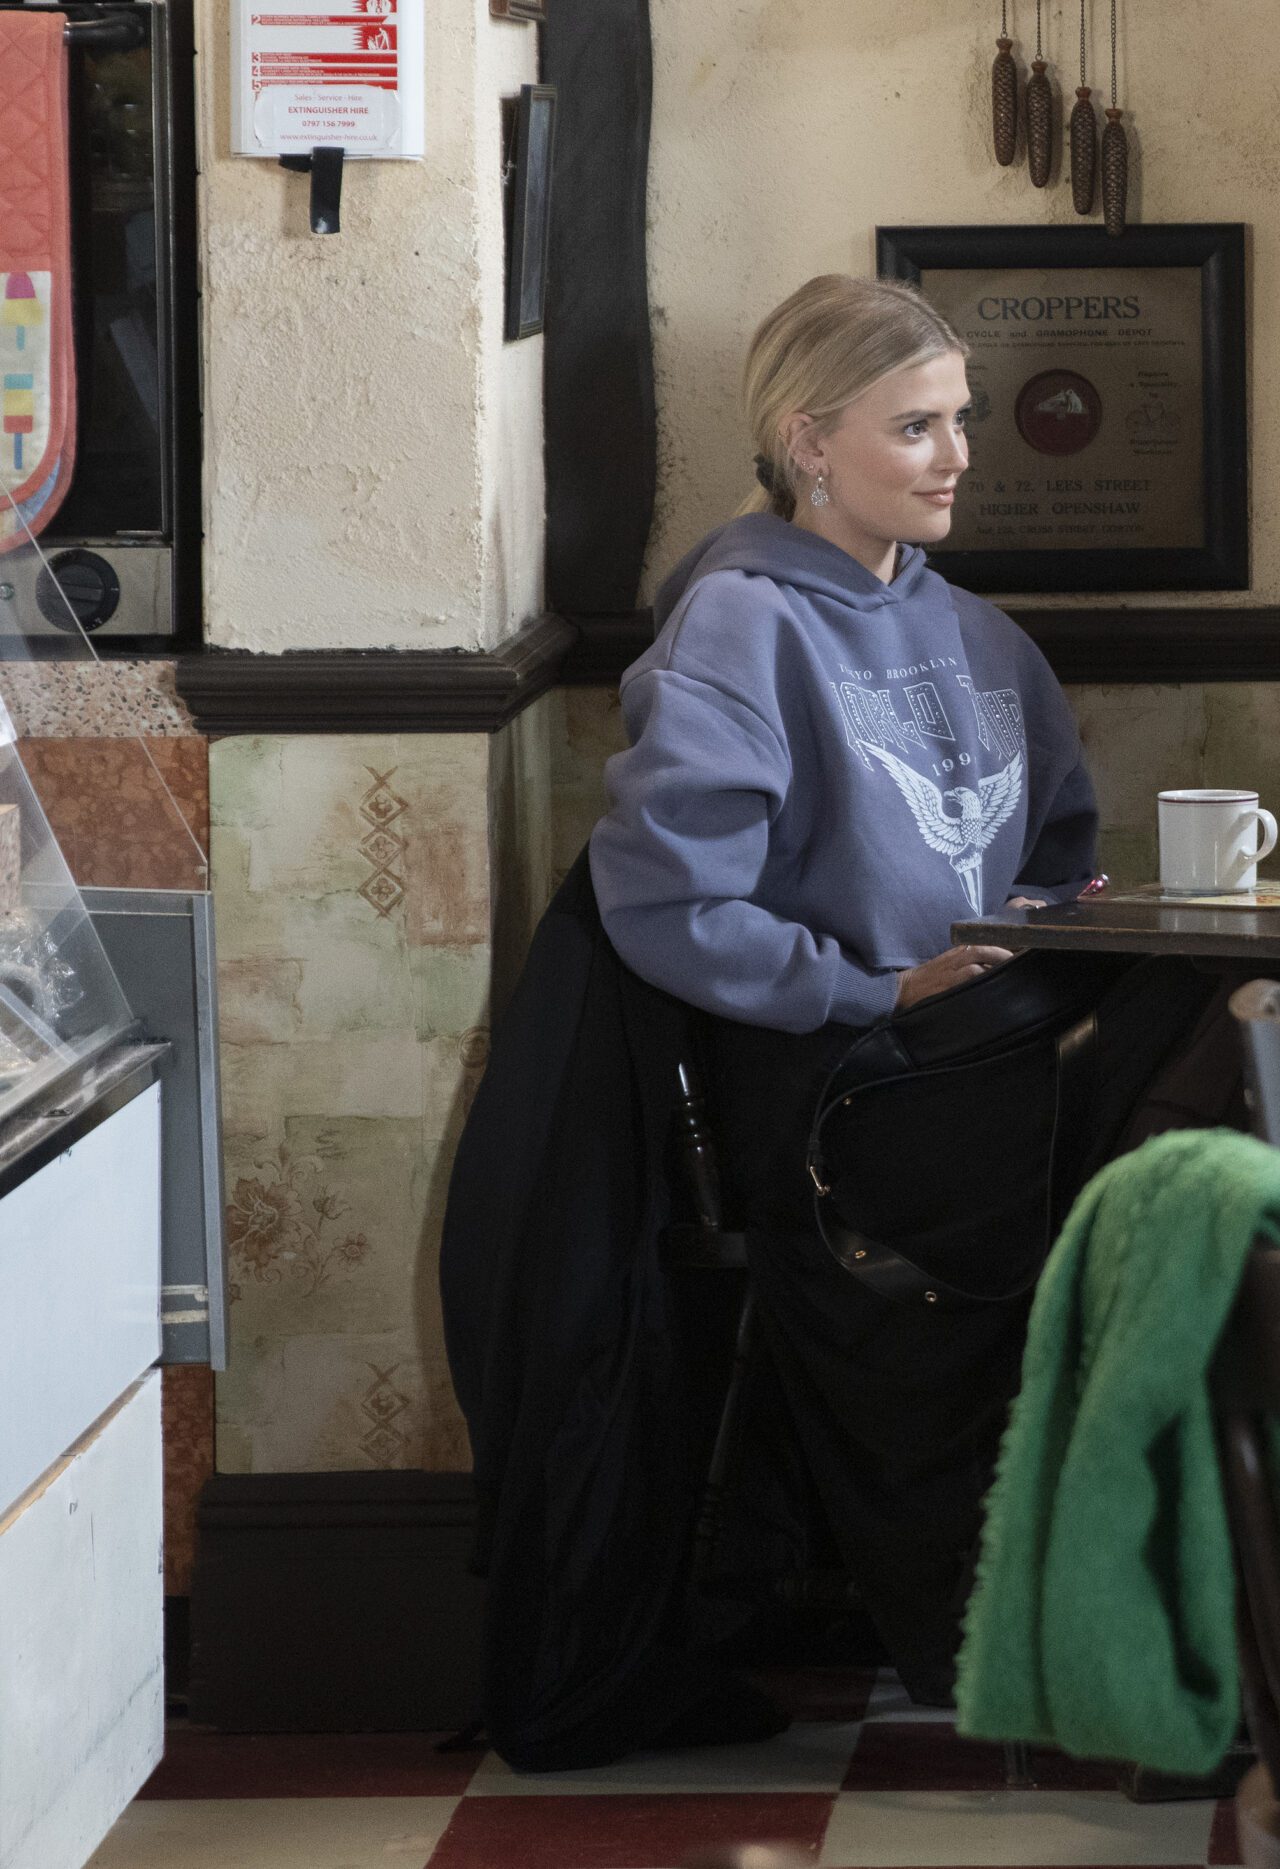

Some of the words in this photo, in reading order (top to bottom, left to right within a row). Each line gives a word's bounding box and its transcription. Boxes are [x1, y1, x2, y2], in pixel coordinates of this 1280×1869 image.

[288, 106, 348, 114] EXTINGUISHER
[977, 295, 1141, 321] CROPPERS
[966, 331, 1001, 339] CYCLE
[1036, 329, 1109, 338] GRAMOPHONE
[1118, 328, 1153, 337] DEPOT
[994, 480, 1007, 493] &
[1094, 479, 1152, 491] STREET
[979, 503, 1040, 516] HIGHER
[1051, 502, 1141, 514] OPENSHAW
[886, 657, 957, 679] BROOKLYN
